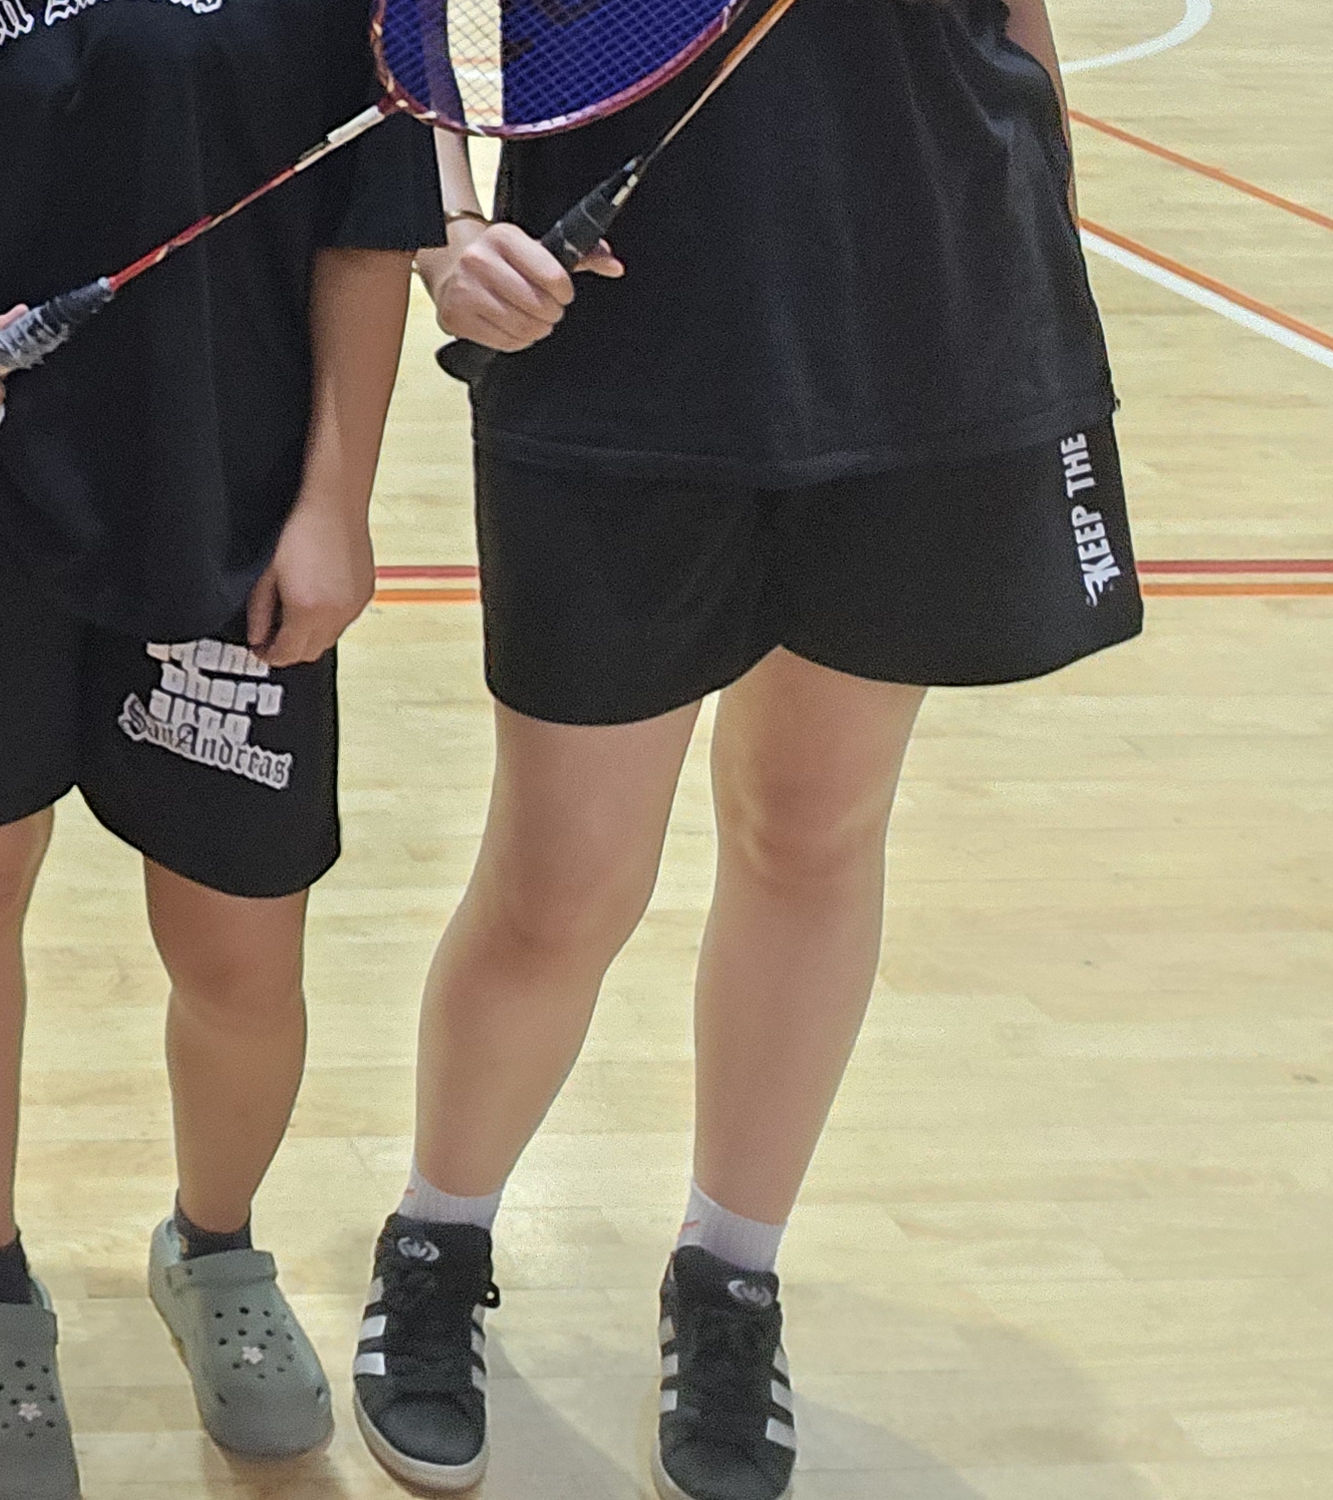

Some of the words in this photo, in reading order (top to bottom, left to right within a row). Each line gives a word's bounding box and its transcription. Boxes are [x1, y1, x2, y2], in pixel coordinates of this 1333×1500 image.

[1060, 432, 1096, 499] THE
[1072, 505, 1121, 607] KEEP
[175, 722, 293, 790] Andreas
